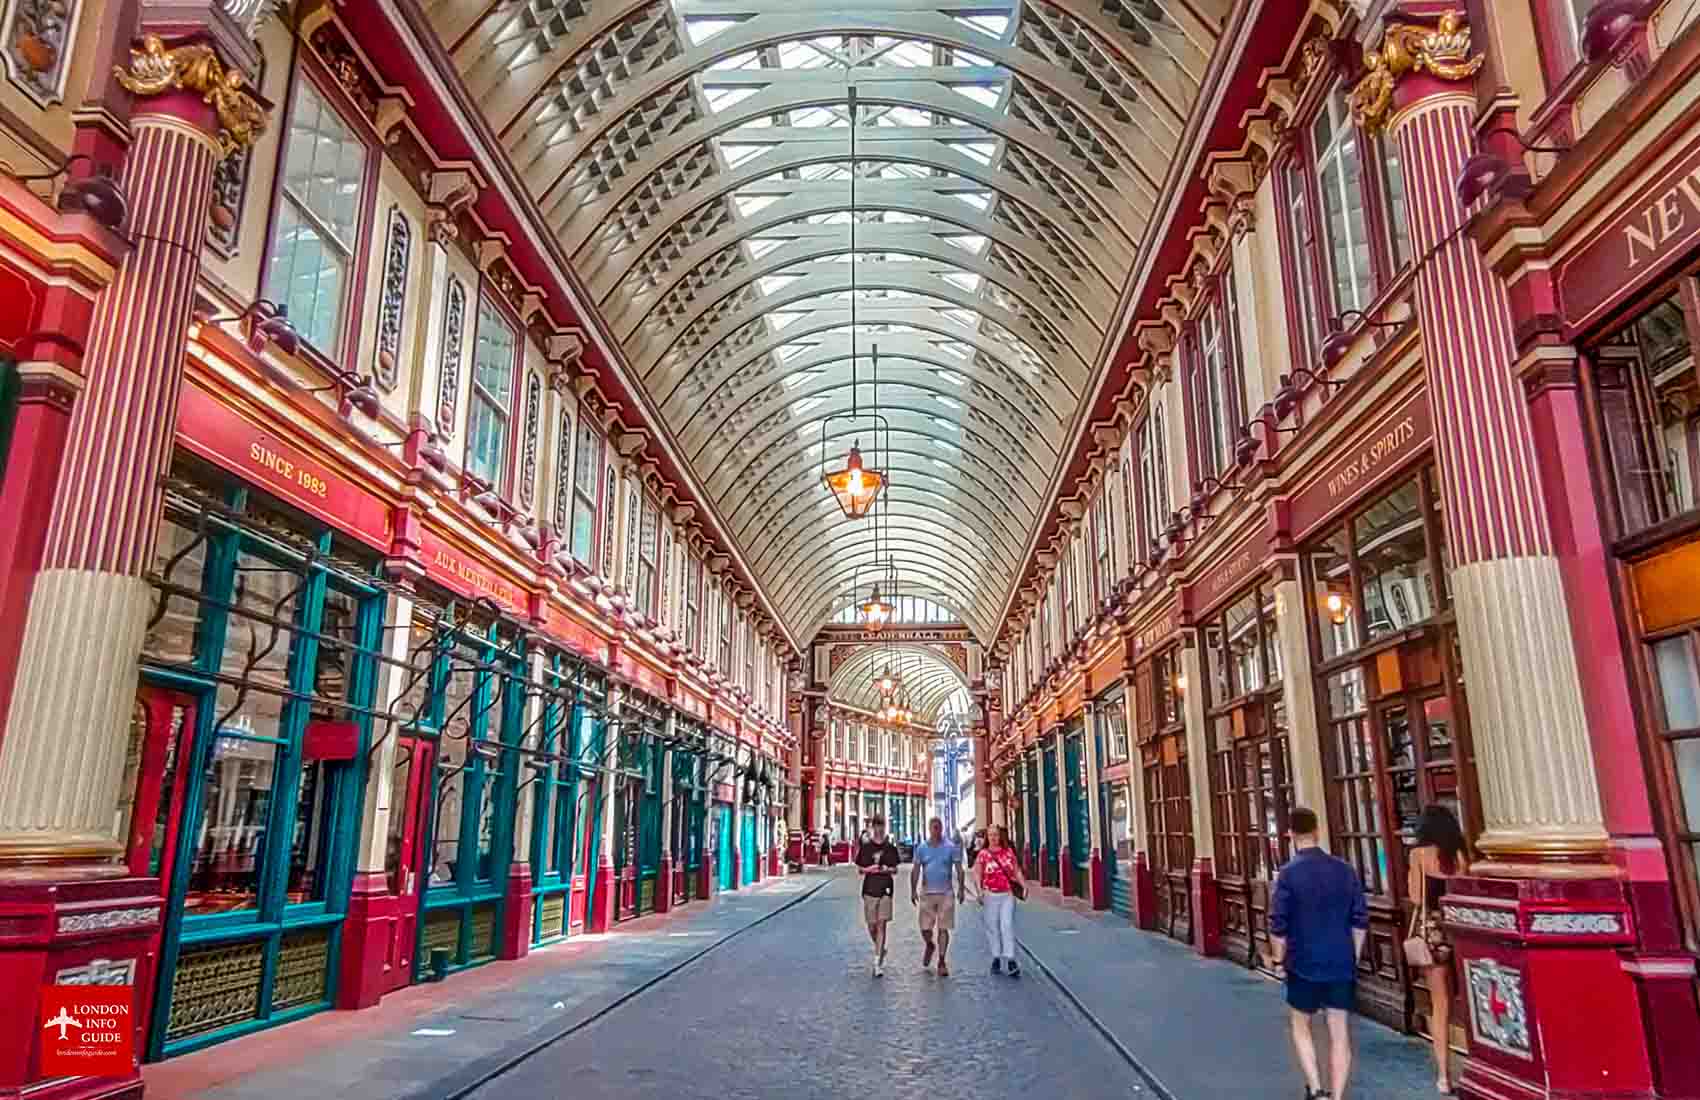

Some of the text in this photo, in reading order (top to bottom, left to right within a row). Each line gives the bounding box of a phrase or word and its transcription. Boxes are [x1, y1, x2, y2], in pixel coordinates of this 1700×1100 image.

[250, 442, 294, 480] SINCE
[1327, 416, 1414, 498] WINES & SPIRITS
[433, 551, 457, 574] AUX
